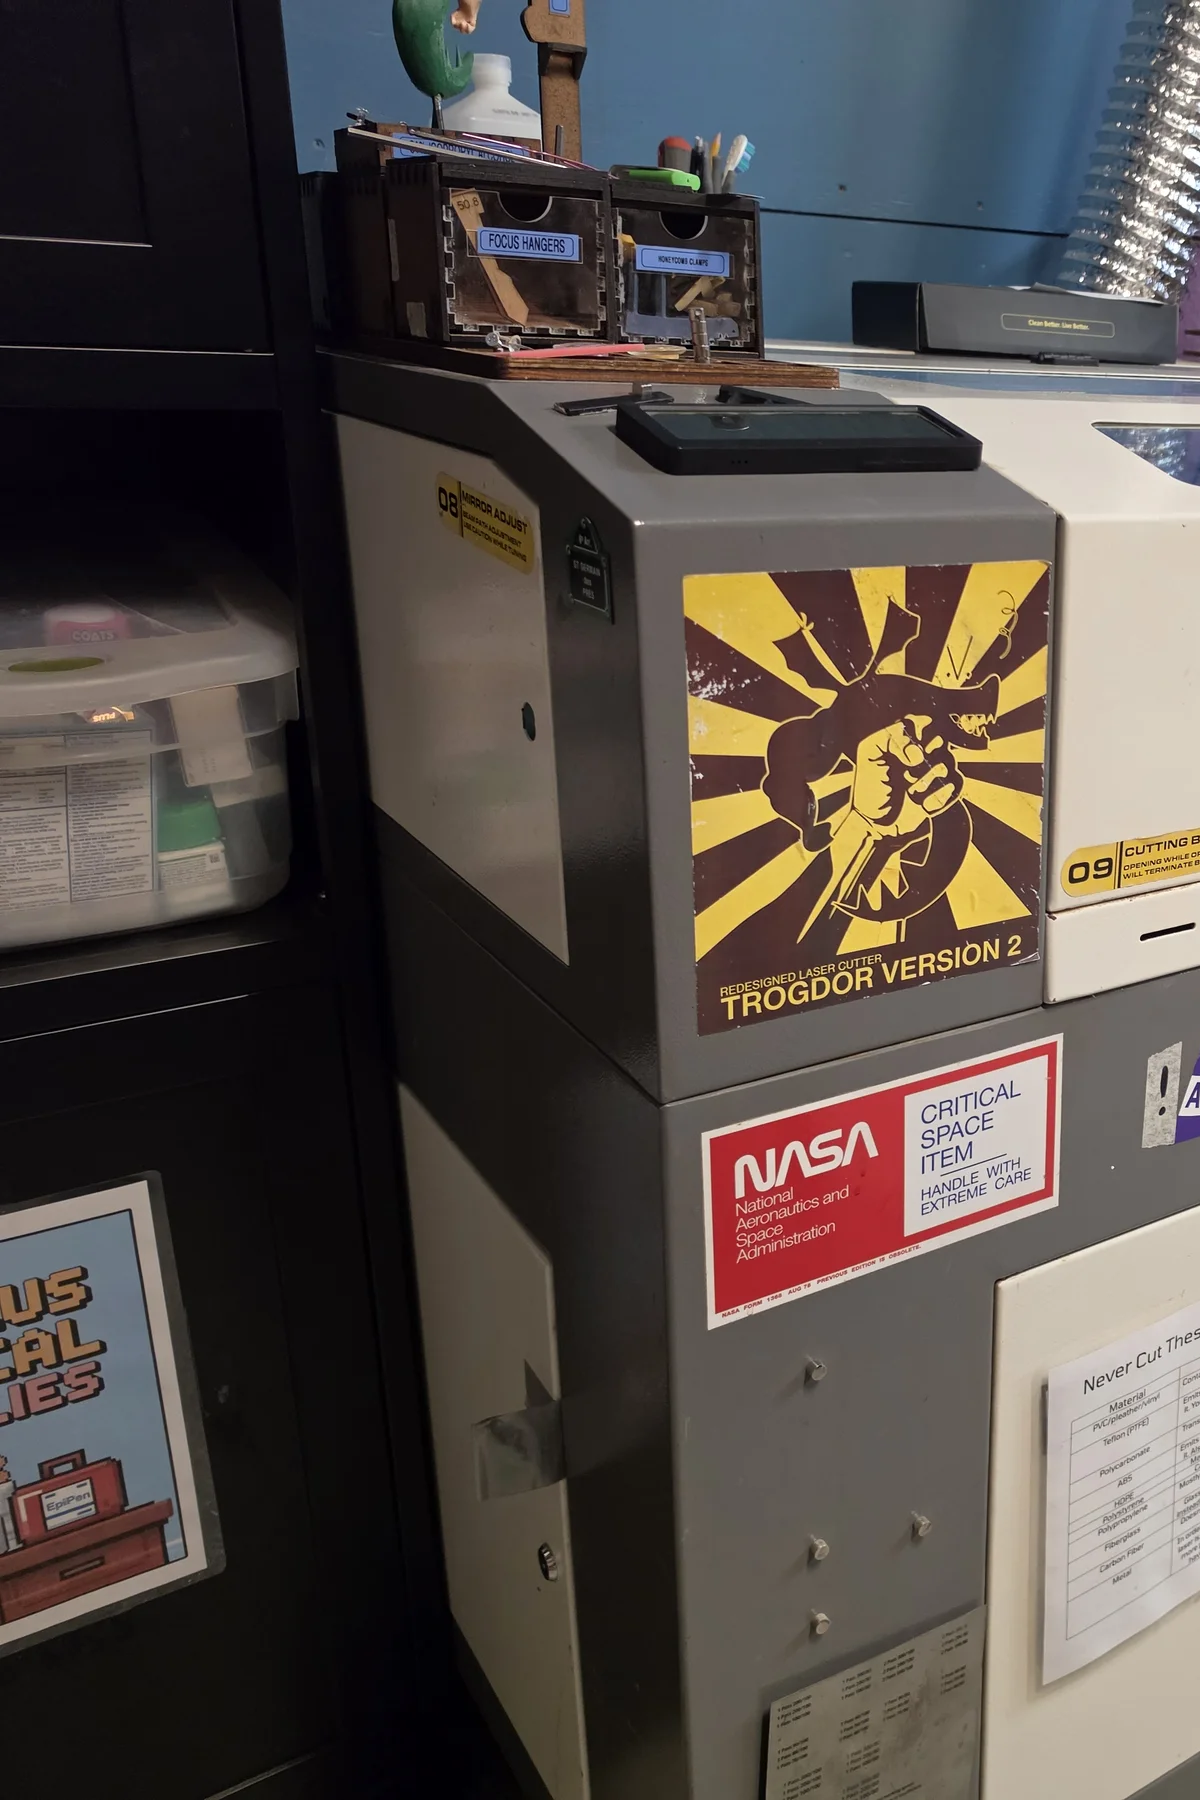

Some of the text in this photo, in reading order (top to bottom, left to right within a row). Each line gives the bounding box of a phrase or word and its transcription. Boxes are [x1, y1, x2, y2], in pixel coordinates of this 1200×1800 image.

[457, 197, 480, 211] 50.8
[488, 233, 566, 254] FOCUS HANGERS
[658, 256, 708, 267] HONEYCOMB CLAMPS
[439, 487, 458, 518] 08
[462, 490, 527, 535] MIRROR ADJUST
[472, 526, 492, 543] CAUTION
[489, 525, 521, 548] ADJUSTMENT
[580, 562, 600, 576] GERMAIN
[72, 630, 114, 642] COATS
[1123, 858, 1162, 871] OPENING
[1163, 852, 1190, 863] WHILE
[1125, 837, 1188, 857] CUTTING
[1068, 857, 1114, 885] 09
[1123, 869, 1143, 880] WILL
[1145, 862, 1193, 876] TERMINATE
[720, 953, 882, 997] REDESIGNED LASER CUTTER
[720, 934, 1022, 1020] TROGDOR VERSION 2
[920, 1079, 1022, 1125] CRITICAL
[920, 1110, 995, 1149] SPACE
[734, 1121, 879, 1200] NASA
[920, 1142, 974, 1175] ITEM
[920, 1157, 1021, 1201] HANDLE WITH
[920, 1167, 1032, 1216] EXTREME CARE
[735, 1187, 794, 1217] National
[735, 1185, 850, 1232] Aeronautics and
[735, 1223, 784, 1249] Space
[736, 1220, 836, 1265] Administration
[0, 1265, 93, 1327] US
[721, 1307, 740, 1319] NASA
[743, 1299, 763, 1311] FORM
[788, 1286, 802, 1296] AUG
[816, 1270, 849, 1286] PREVIOUS
[851, 1260, 877, 1273] EDITION
[888, 1243, 922, 1260] OBSOLETE.
[1083, 1361, 1132, 1395] Never
[1136, 1346, 1162, 1369] Cut
[1093, 1391, 1160, 1433] PVC/pleather/vinyl
[1109, 1387, 1145, 1414] Material
[1103, 1416, 1149, 1447] Teflon (PTFE)
[1099, 1445, 1150, 1478] Polycarbonate
[1117, 1473, 1132, 1488] ABS
[46, 1491, 91, 1511] EpiPen
[1102, 1496, 1143, 1525] Polystyrene
[1114, 1491, 1134, 1508] HDPE
[1097, 1503, 1148, 1537] Polypropylene
[1104, 1526, 1140, 1552] Fiberglass
[1099, 1542, 1144, 1573] Carbon Fiber
[1112, 1568, 1131, 1584] Metal
